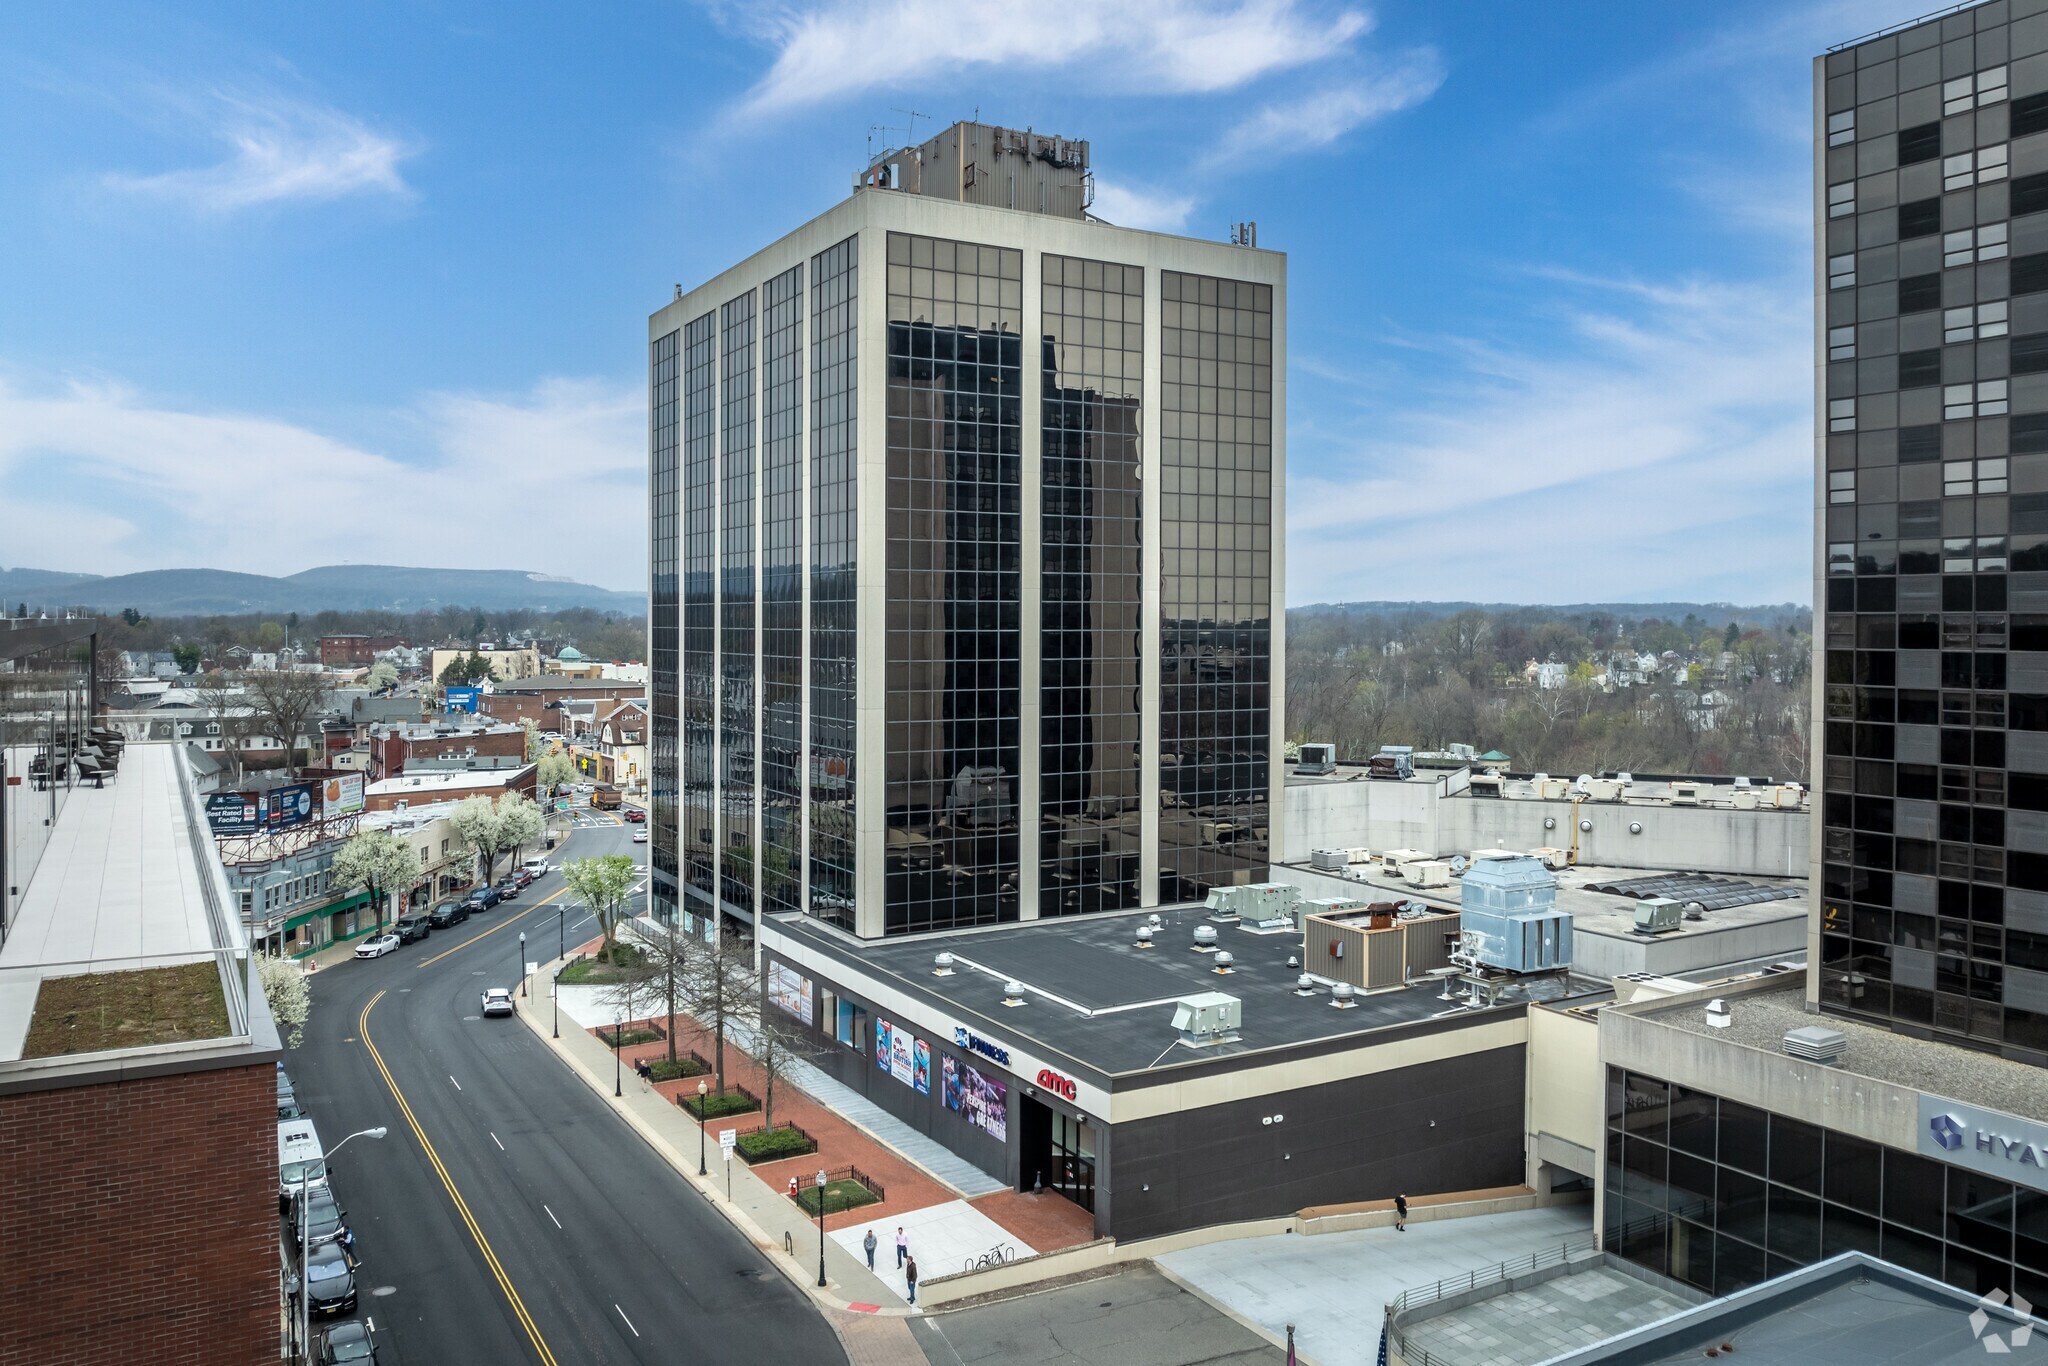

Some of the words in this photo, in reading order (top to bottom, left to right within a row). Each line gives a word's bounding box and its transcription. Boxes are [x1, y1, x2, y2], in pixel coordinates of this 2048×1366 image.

[217, 816, 242, 824] Facility
[222, 809, 242, 817] Rated
[970, 1033, 1009, 1066] FITNESS
[1976, 1129, 2048, 1168] HYA
